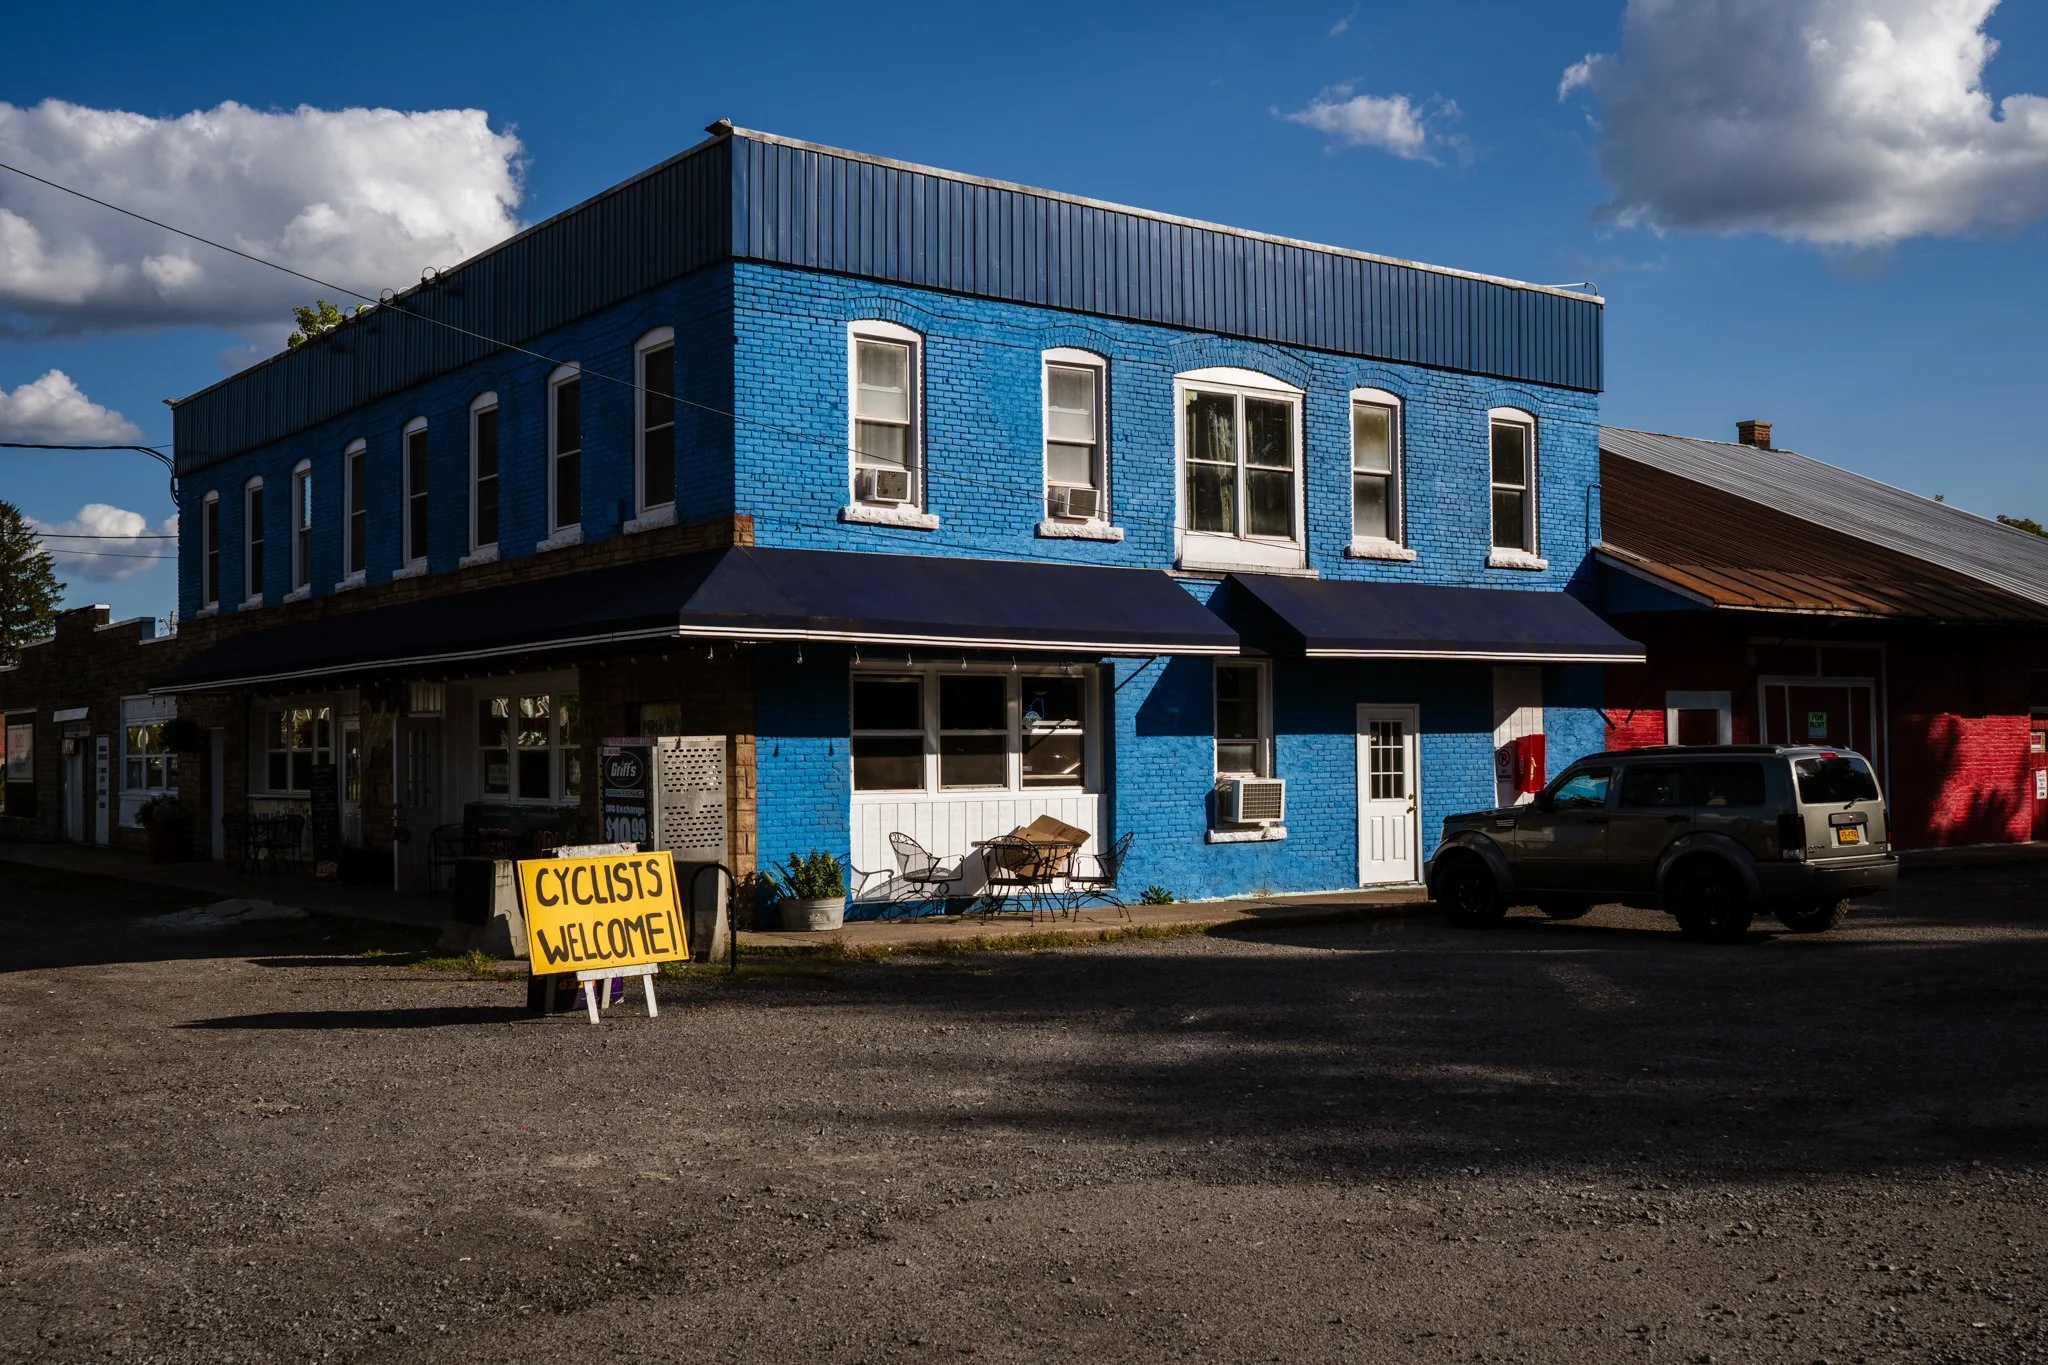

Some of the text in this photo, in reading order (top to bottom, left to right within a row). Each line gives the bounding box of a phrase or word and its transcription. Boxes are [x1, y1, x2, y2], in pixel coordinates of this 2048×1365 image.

[1809, 721, 1825, 729] RENT
[610, 759, 637, 777] Griff's
[616, 804, 646, 817] Exchange
[535, 859, 663, 907] CYCLISTS
[537, 910, 678, 966] WELCOME!
